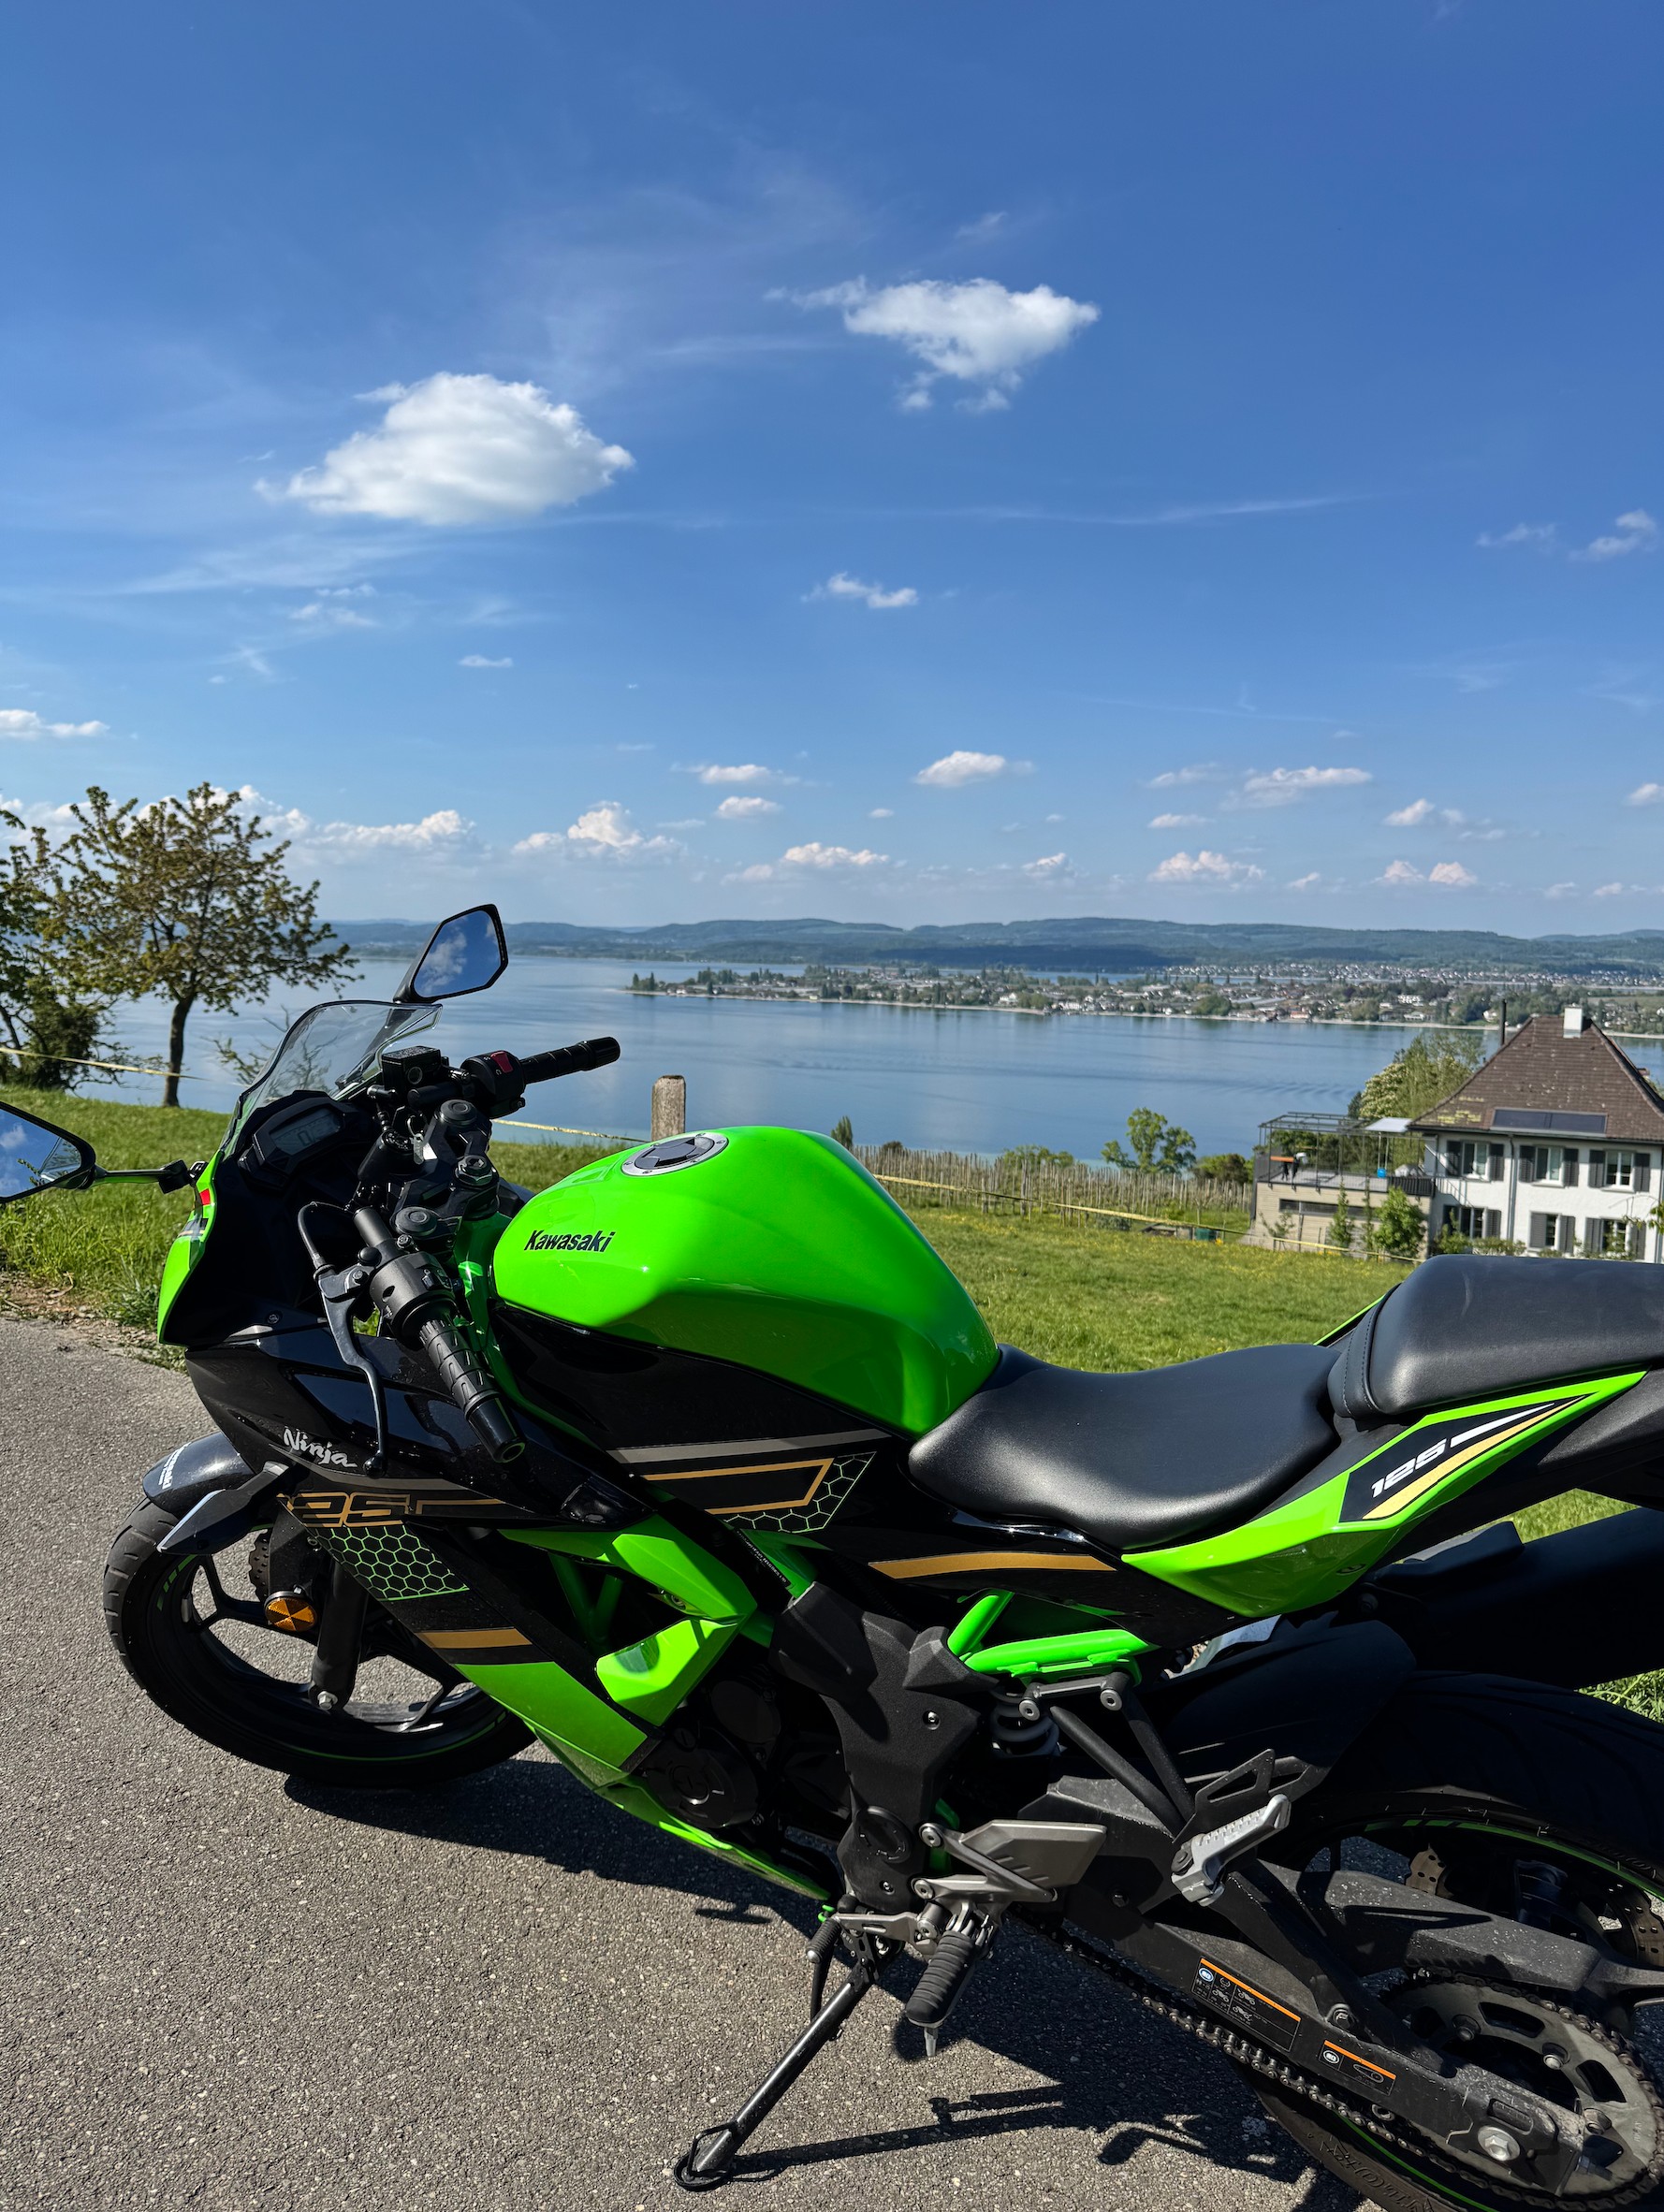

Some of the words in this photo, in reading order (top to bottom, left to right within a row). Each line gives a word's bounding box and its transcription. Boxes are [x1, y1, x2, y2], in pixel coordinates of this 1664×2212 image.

[524, 1230, 616, 1253] Kawasaki
[284, 1426, 358, 1467] Ninja
[1371, 1438, 1447, 1498] 125
[276, 1492, 410, 1528] 25
